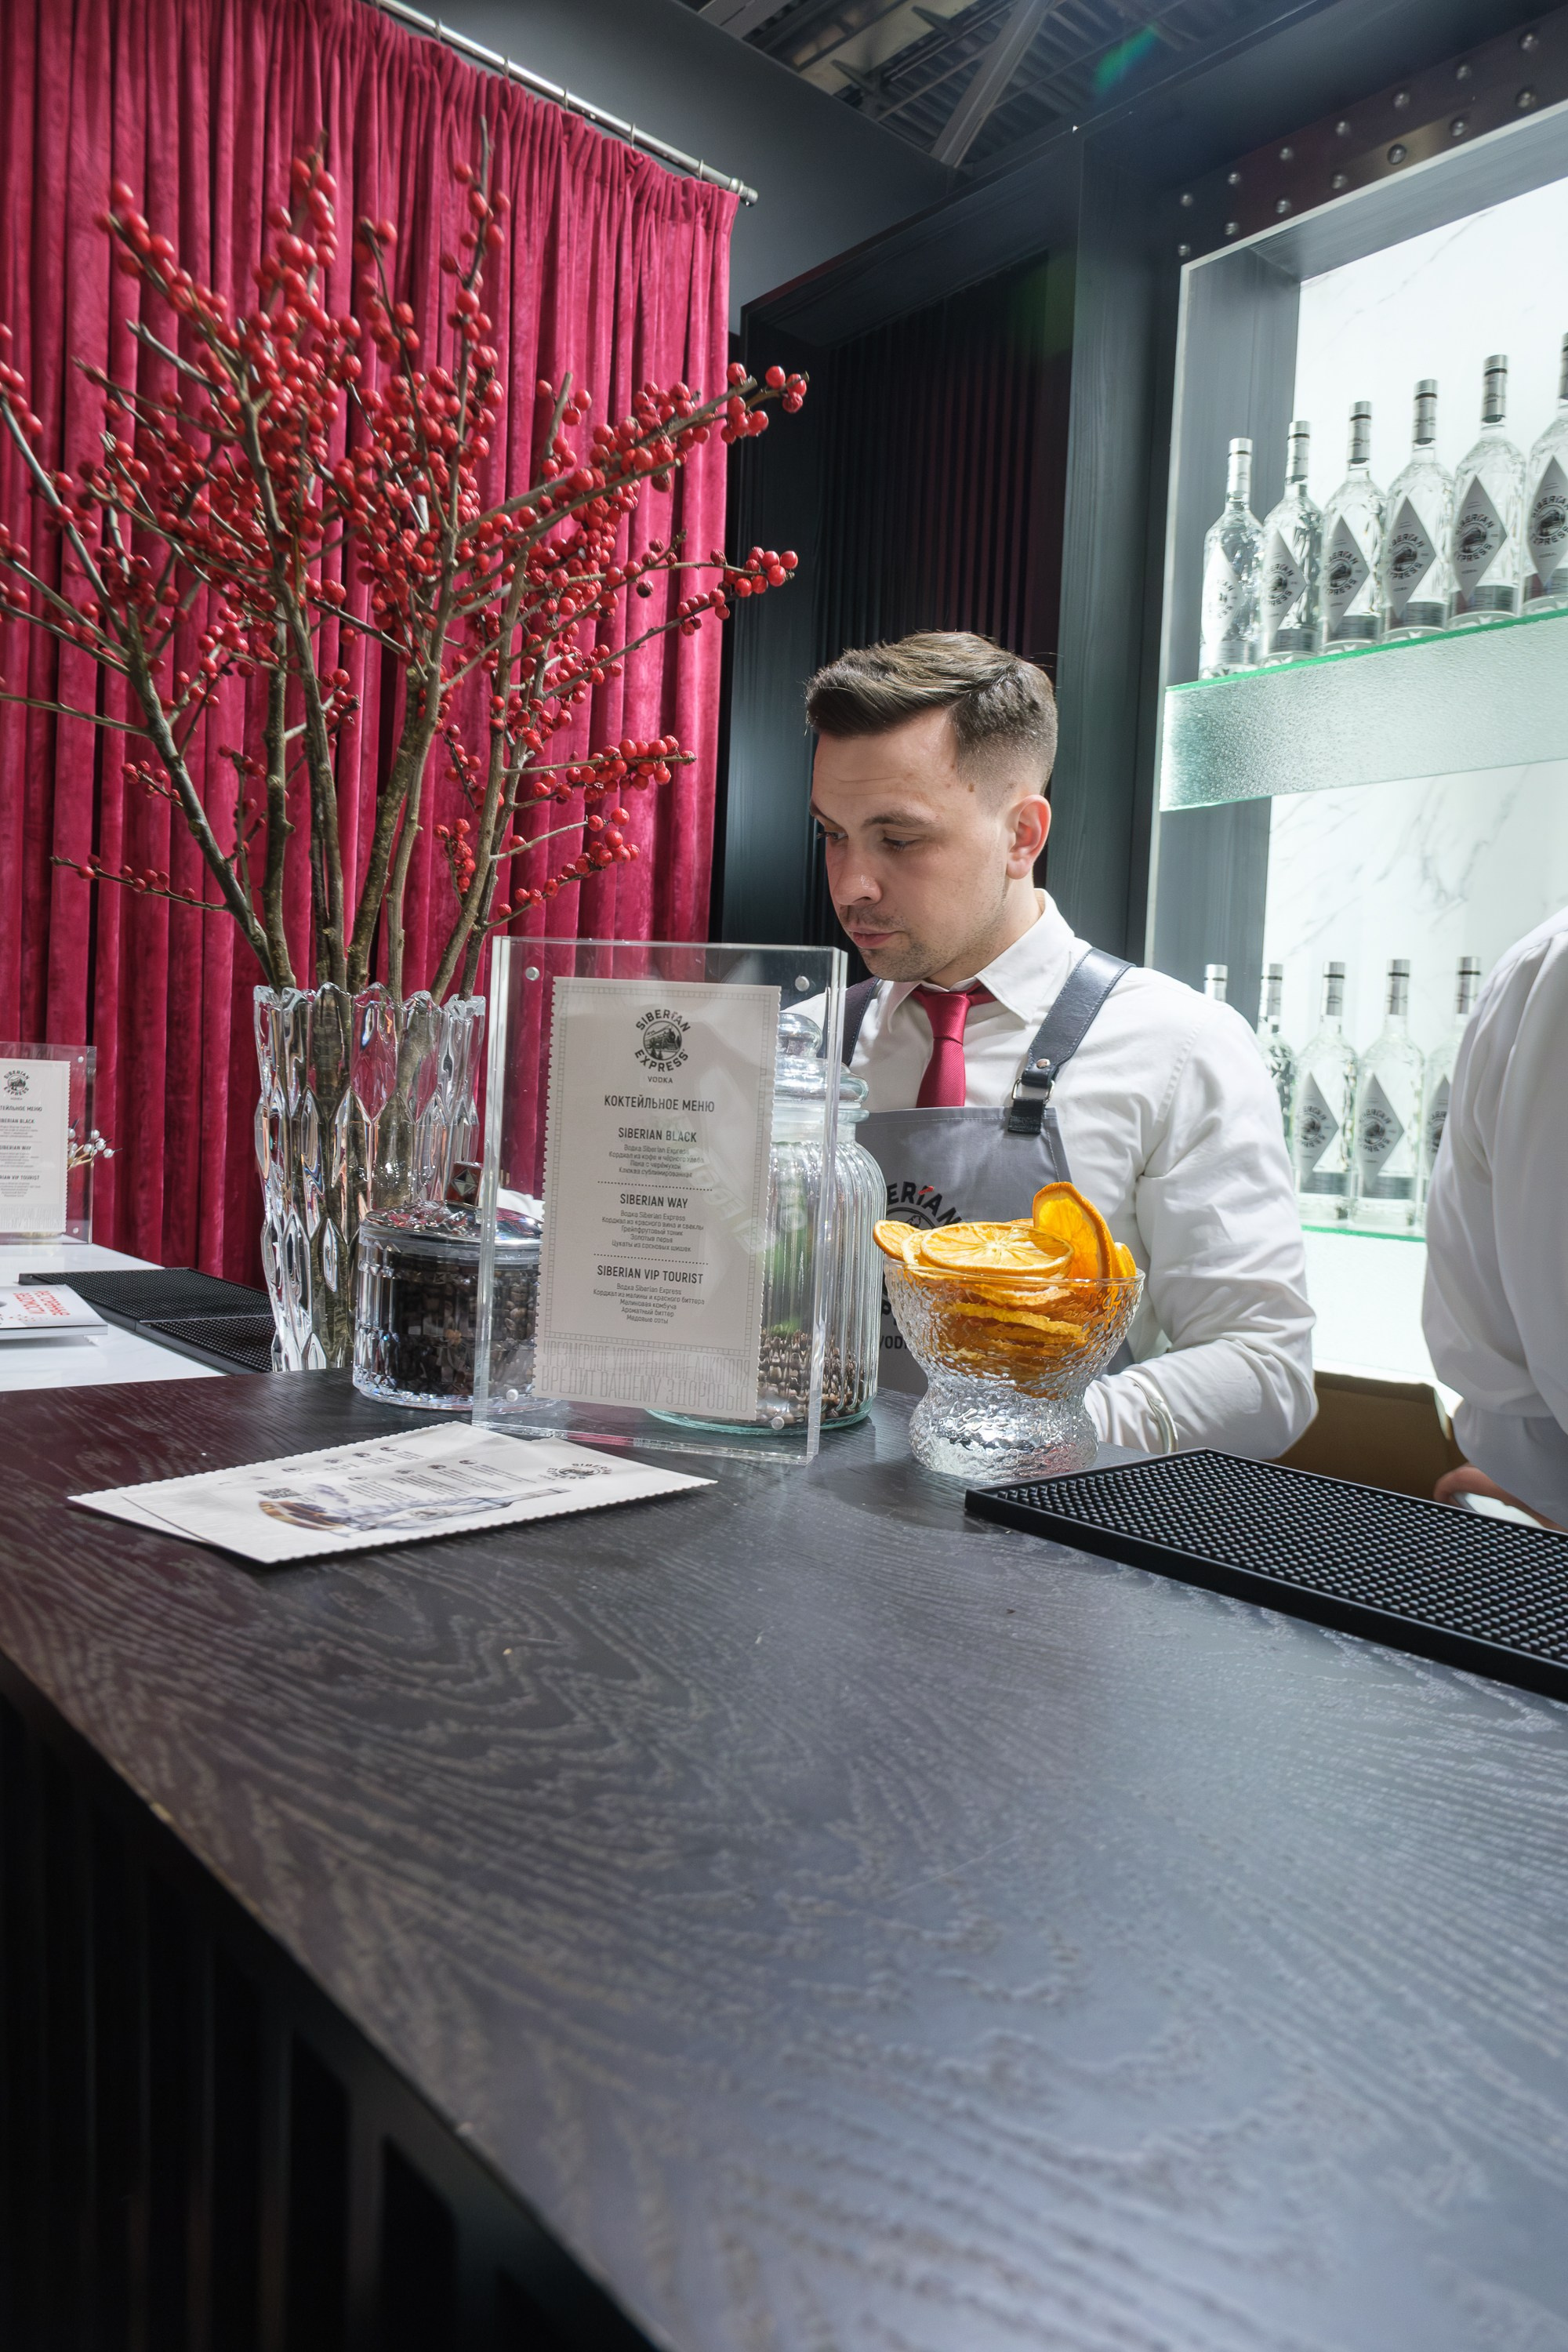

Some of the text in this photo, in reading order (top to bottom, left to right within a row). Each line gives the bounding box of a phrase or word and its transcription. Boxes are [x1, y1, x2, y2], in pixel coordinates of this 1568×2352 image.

[636, 1009, 691, 1032] SIBERIAN
[634, 1049, 688, 1072] EXPRESS
[604, 1094, 715, 1112] КОКТЕЙЛЬНОЕ МЕНЮ
[619, 1127, 697, 1142] SIBERIAN BLACK
[643, 1145, 666, 1153] Siberian
[620, 1193, 688, 1208] SIBERIAN WAY
[887, 1181, 962, 1225] ERIAN
[662, 1213, 686, 1221] Express
[597, 1265, 703, 1284] SIBERIAN VIP TOURIST
[635, 1284, 658, 1293] Siberian
[659, 1287, 681, 1295] Express
[655, 1309, 674, 1318] биттер
[542, 1365, 749, 1412] ВРЕДИТ ВАШЕМУ ЗДОРОВЬЮ
